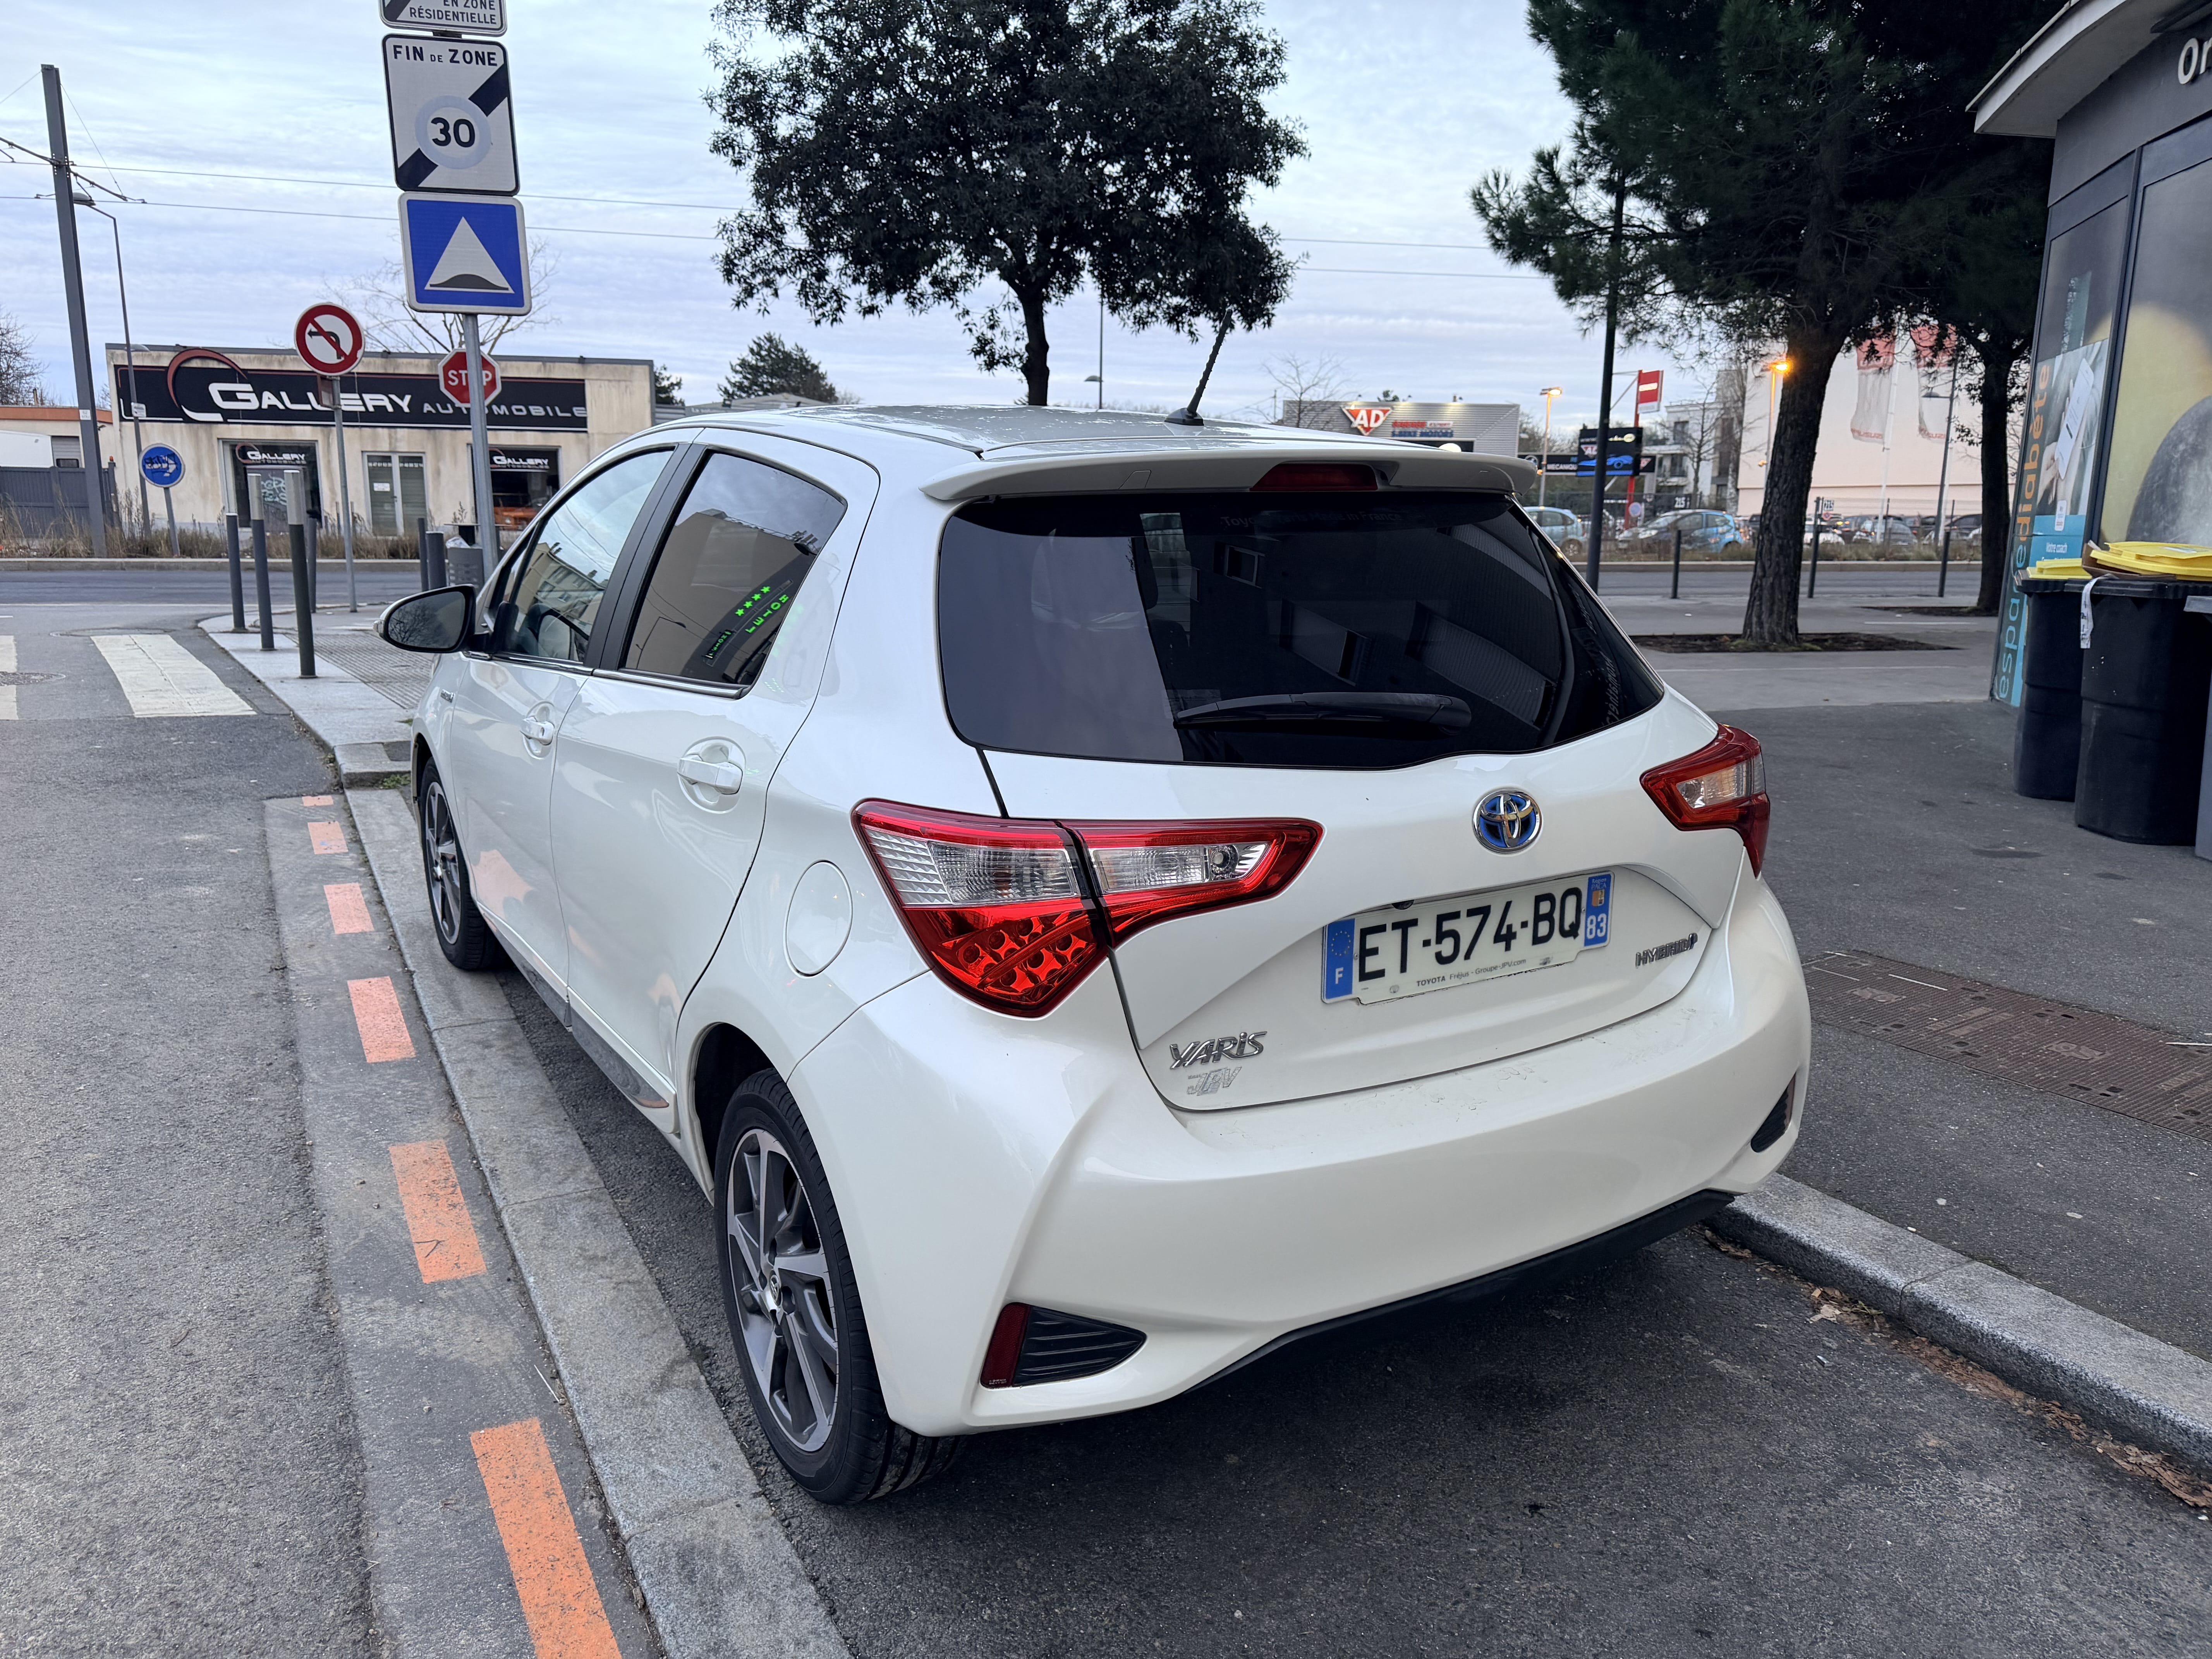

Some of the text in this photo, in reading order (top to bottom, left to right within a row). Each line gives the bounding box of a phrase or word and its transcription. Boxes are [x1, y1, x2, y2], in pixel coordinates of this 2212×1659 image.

[409, 6, 497, 24] RÉSIDENTIELLE
[464, 0, 496, 10] ZONE
[393, 45, 498, 66] FIN DE ZONE
[431, 117, 476, 148] 30
[448, 369, 492, 386] STP
[208, 383, 587, 417] GALLERY AUTMOBILE
[1351, 409, 1384, 428] AD
[247, 451, 305, 460] GALLERY
[493, 456, 548, 465] GALLERY
[2016, 365, 2051, 541] diabète
[1334, 967, 1344, 985] F
[1587, 913, 1607, 939] 83
[1417, 976, 1446, 987] TOYOTA
[1449, 971, 1469, 981] Fréjus
[1475, 959, 1526, 975] Groupe-JPV.com
